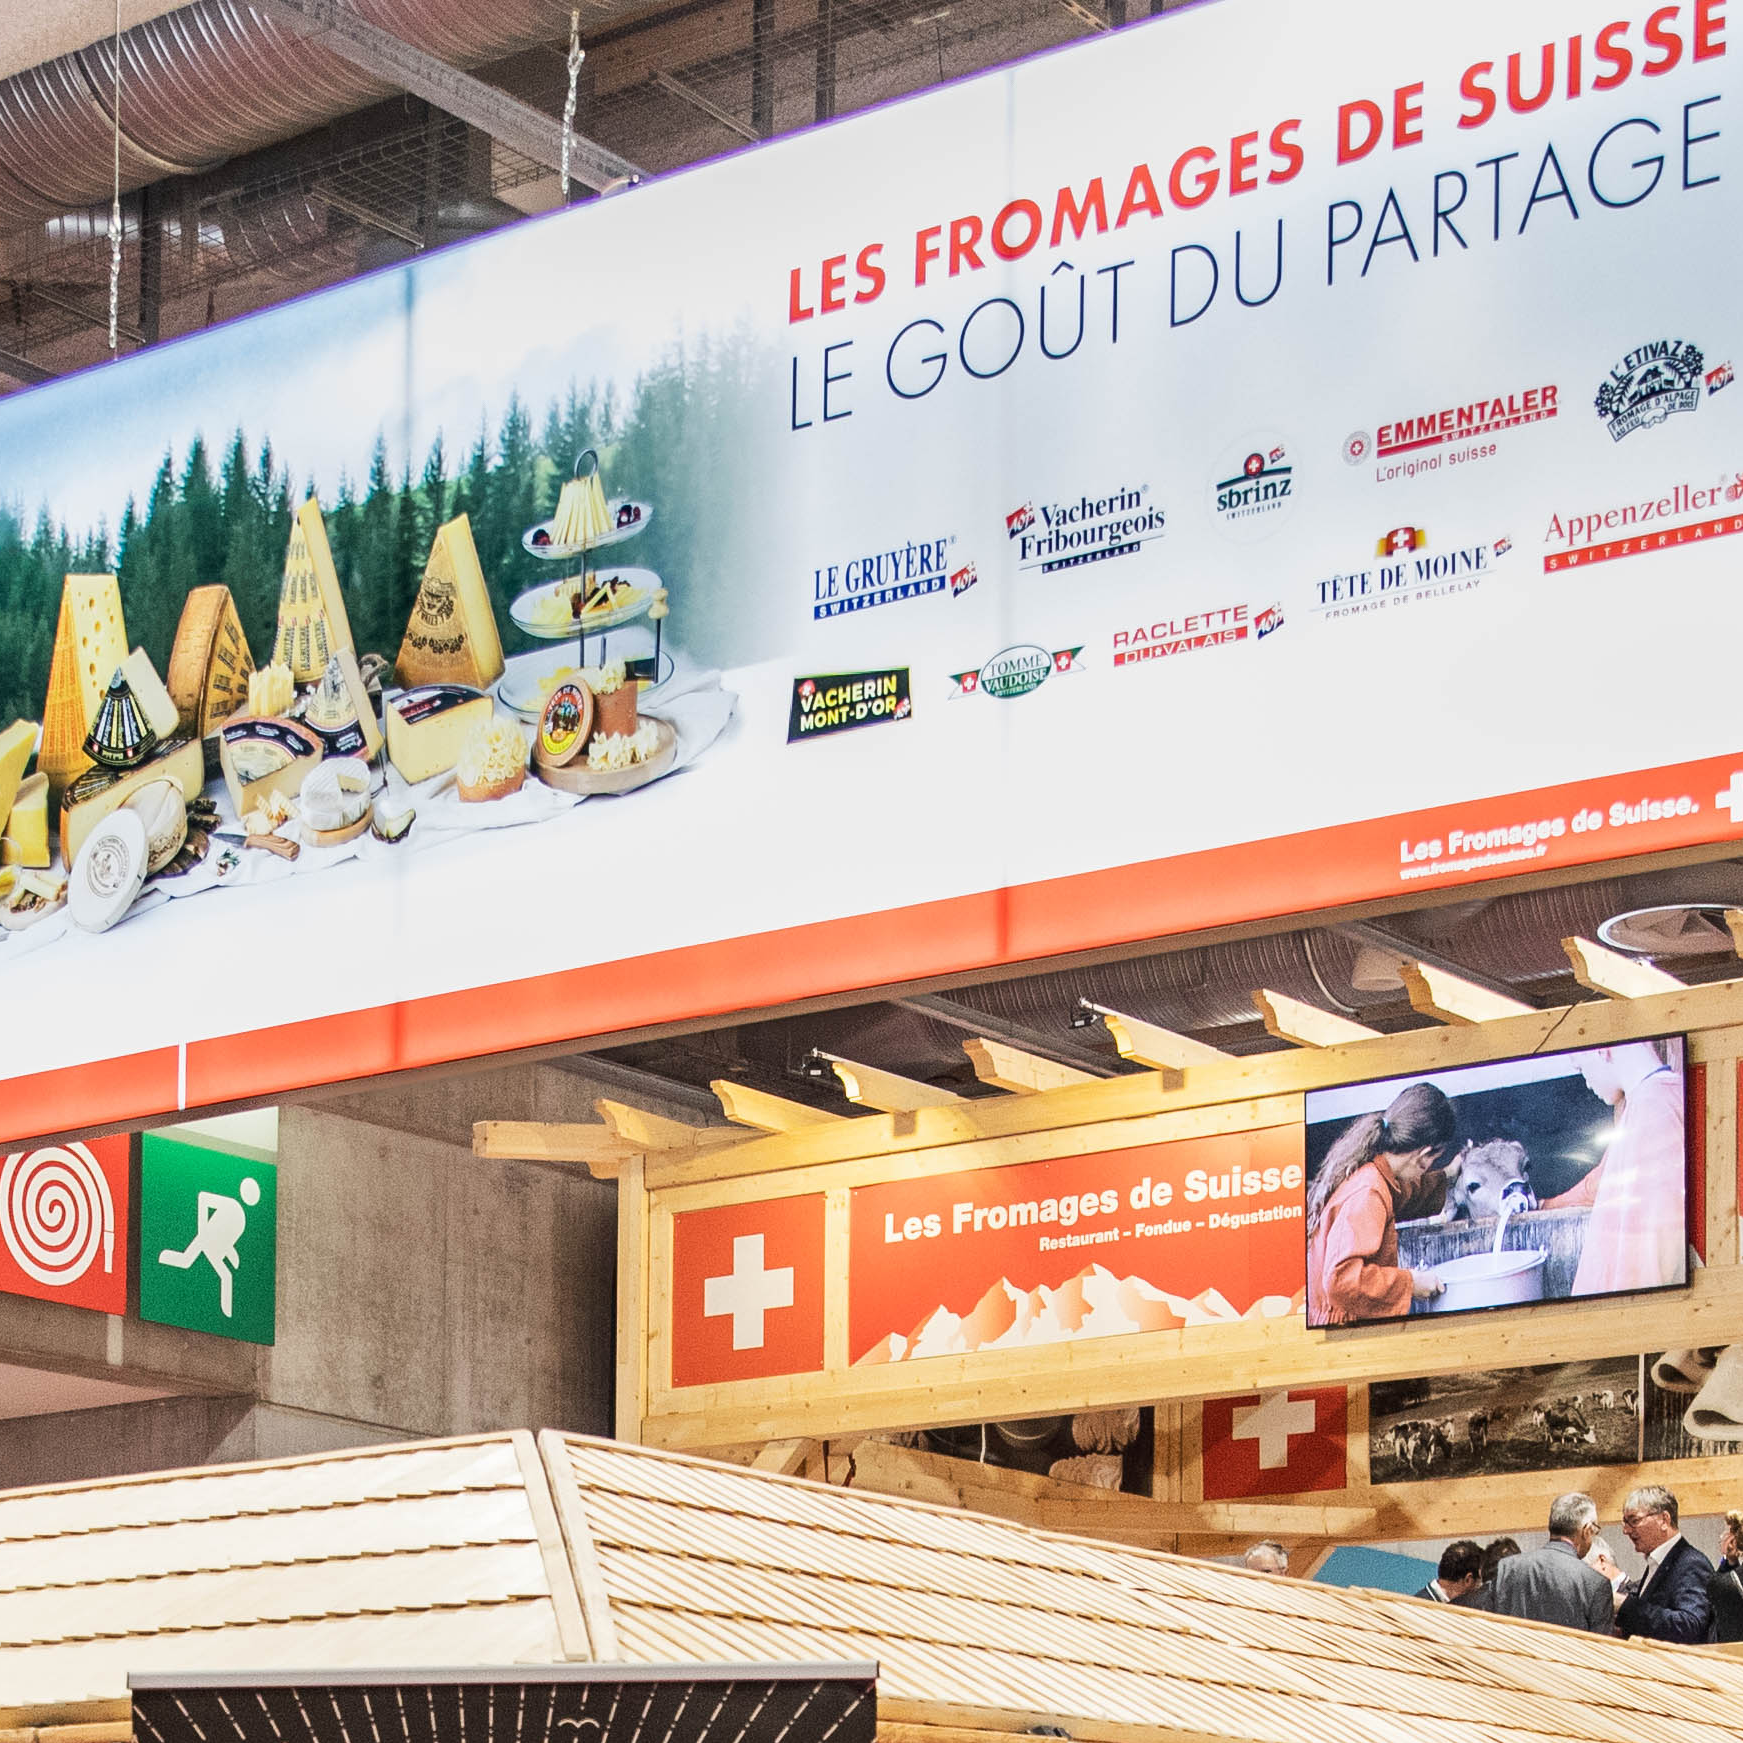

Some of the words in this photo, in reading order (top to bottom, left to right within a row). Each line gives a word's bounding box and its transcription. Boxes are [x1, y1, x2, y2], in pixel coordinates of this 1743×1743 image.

[790, 239, 887, 324] LES
[915, 118, 1304, 288] FROMAGES
[1336, 81, 1425, 168] DE
[1458, 0, 1728, 131] SUISSE
[791, 341, 853, 430] LE
[886, 260, 1132, 401] GOÛT
[1170, 218, 1284, 328] DU
[1328, 95, 1722, 287] PARTAGE
[1377, 385, 1558, 448] EMMENTALER
[1442, 410, 1549, 442] SWITZERLAND
[1611, 401, 1653, 431] FROMAGE
[1655, 390, 1696, 407] D'ALPAGE
[1627, 417, 1641, 433] FEU
[1668, 402, 1677, 410] DE
[1377, 454, 1442, 482] L'original
[1449, 444, 1497, 465] suisse
[1041, 487, 1141, 528] Vacherin
[1217, 478, 1292, 513] sbrinz
[1545, 484, 1722, 546] Appenzeller
[1019, 507, 1165, 561] Fribourgeois
[1549, 519, 1743, 569] SWITZERLAND
[814, 566, 839, 601] LE
[845, 538, 948, 595] GRUYÈRE
[1317, 573, 1372, 604] TÊTE
[1381, 563, 1407, 591] DE
[1416, 546, 1488, 585] MOINE
[819, 577, 941, 619] SWITZERLAND
[1325, 600, 1386, 620] FROMAGE
[1393, 595, 1409, 606] DE
[1416, 580, 1481, 600] BELLELAY
[1114, 604, 1248, 648] RACLETTE
[1124, 648, 1154, 666] DU
[1162, 629, 1237, 656] VALAIS
[983, 668, 1050, 694] VAUDOISE
[991, 654, 1044, 678] TOMME
[801, 674, 898, 713] VACHERIN
[1400, 840, 1442, 863] Les
[1448, 816, 1566, 855] Fromages
[1572, 808, 1602, 831] de
[884, 1210, 941, 1244] Les
[953, 1184, 1120, 1235] Fromages
[1130, 1174, 1173, 1210] de
[1184, 1162, 1303, 1199] Suisse
[1039, 1228, 1121, 1252] Restaurant
[1135, 1216, 1192, 1240] Fondue
[1208, 1204, 1303, 1231] Dégustation
